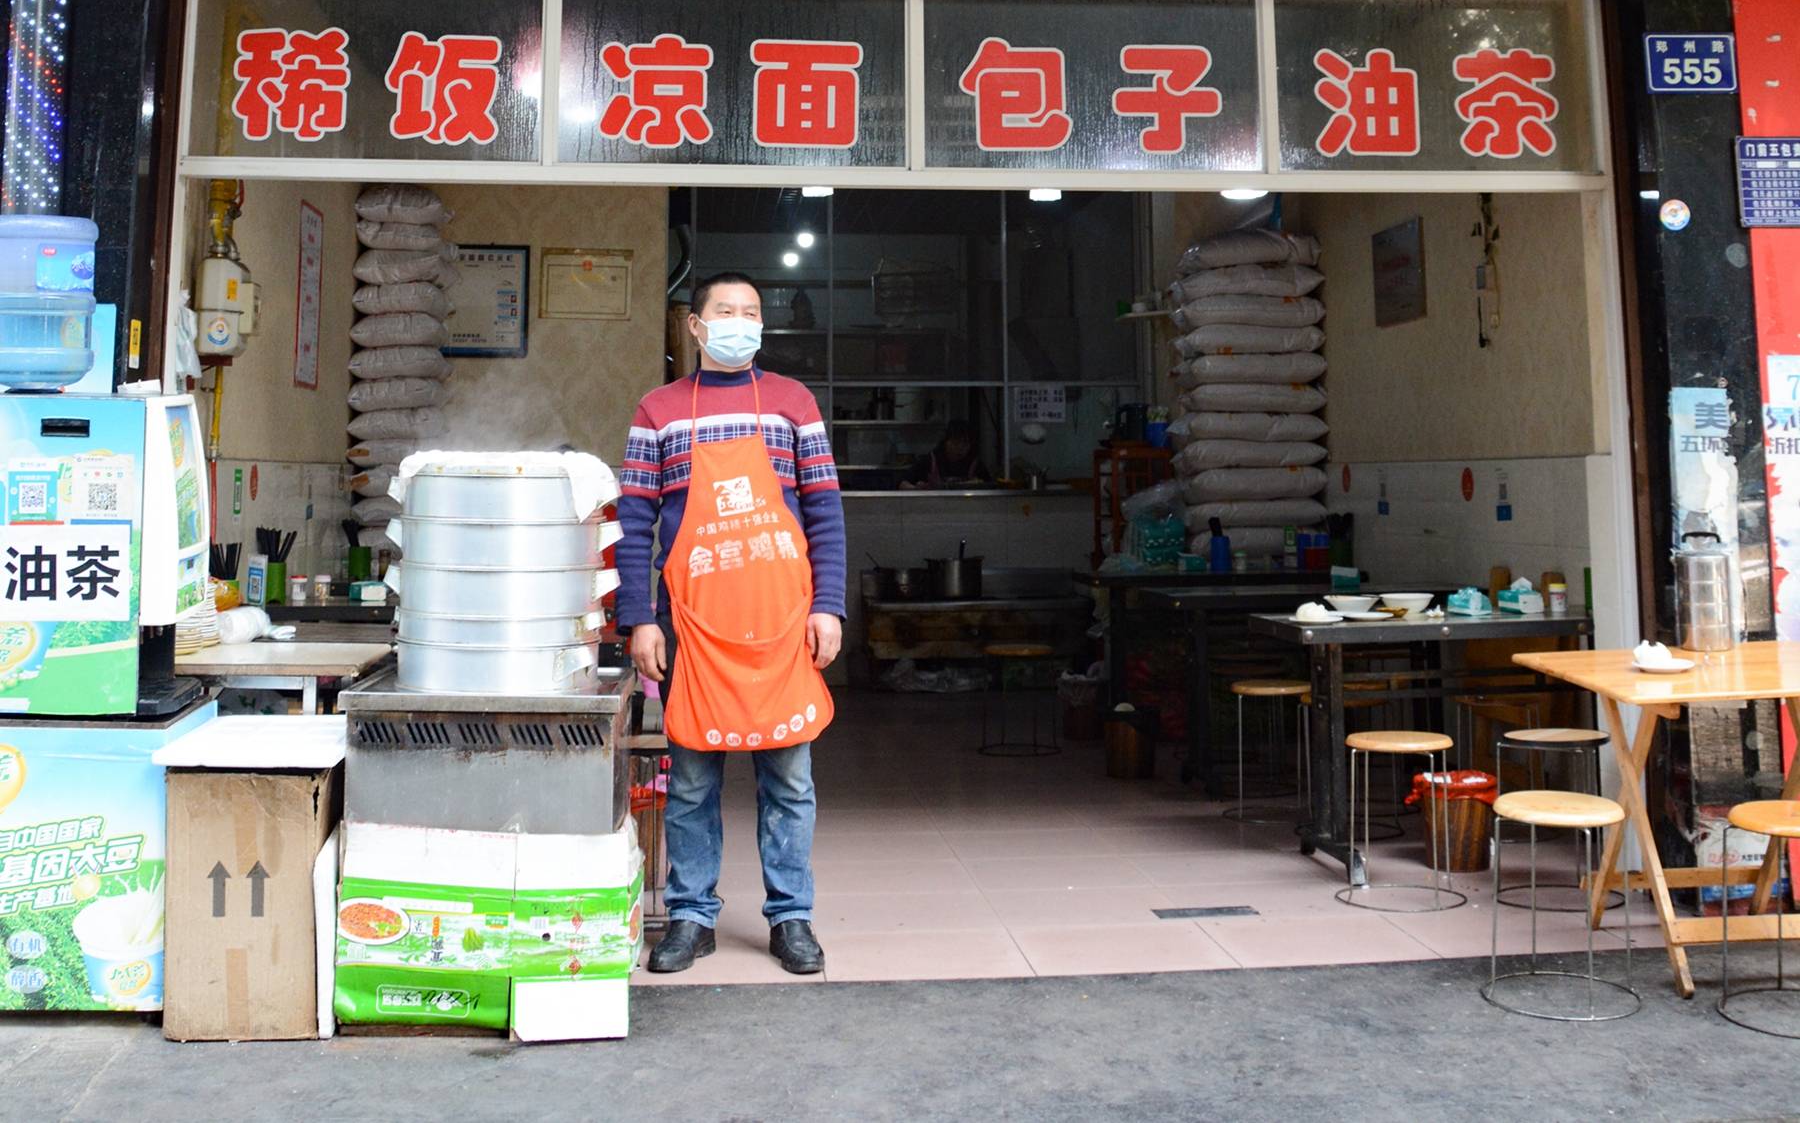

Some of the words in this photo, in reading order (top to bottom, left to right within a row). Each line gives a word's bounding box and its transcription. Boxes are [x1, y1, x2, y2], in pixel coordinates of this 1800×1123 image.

[1655, 40, 1725, 53] 郑州路
[1663, 58, 1722, 85] 555
[232, 27, 501, 145] 稀饭
[599, 33, 864, 149] 凉面
[959, 36, 1223, 154] 包子
[1314, 47, 1560, 160] 油茶
[1695, 401, 1730, 430] 美
[4, 545, 121, 601] 油茶
[688, 530, 799, 578] 金宫鸡精
